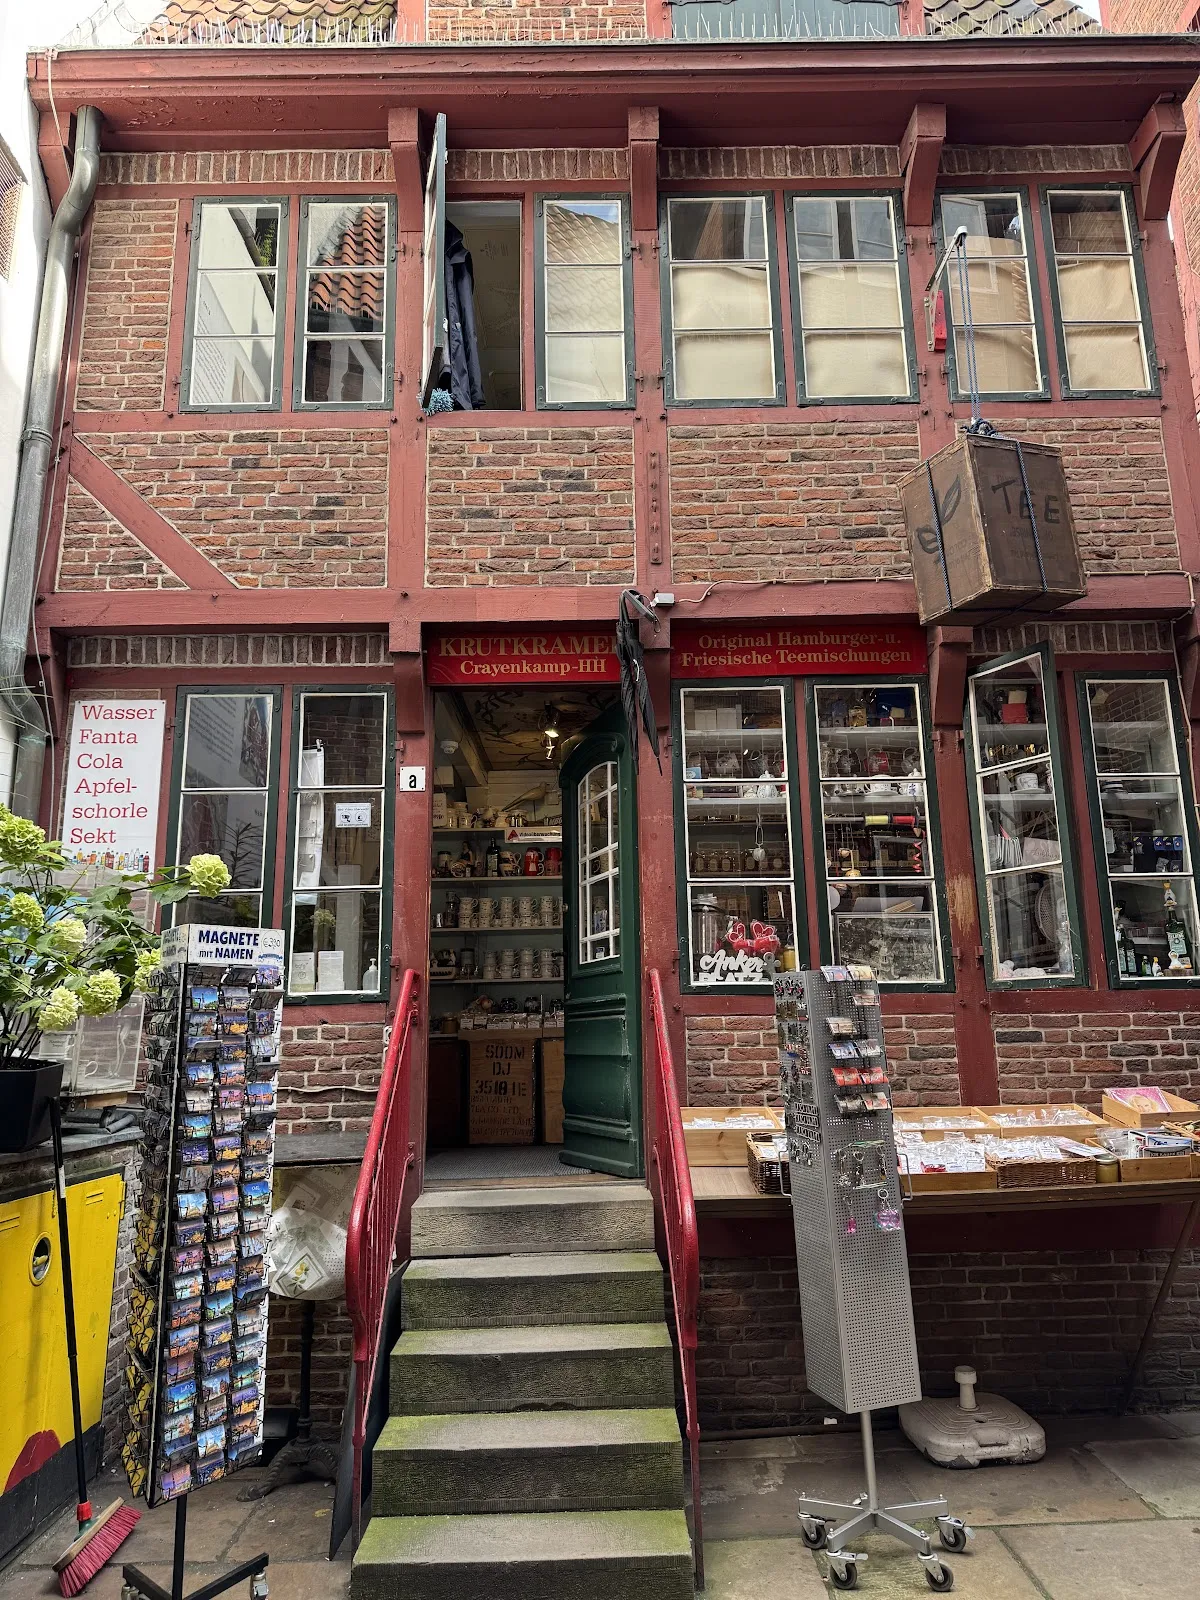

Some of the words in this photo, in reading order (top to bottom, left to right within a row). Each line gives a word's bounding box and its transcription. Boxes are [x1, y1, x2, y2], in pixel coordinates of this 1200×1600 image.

[991, 479, 1061, 524] TEE
[699, 633, 772, 650] Original
[681, 651, 772, 667] Friesische
[776, 649, 912, 664] Teemischungen
[460, 658, 607, 677] Crayenkamp-HH
[82, 705, 157, 720] Wasser
[79, 729, 138, 744] Fanta
[77, 753, 123, 769] Cola
[74, 778, 137, 797] Apfel-
[409, 774, 417, 789] a
[72, 803, 148, 819] schorle
[70, 828, 116, 844] Sekt
[198, 930, 260, 947] MAGNETE
[215, 947, 254, 960] NAMEN
[700, 949, 765, 977] Anker
